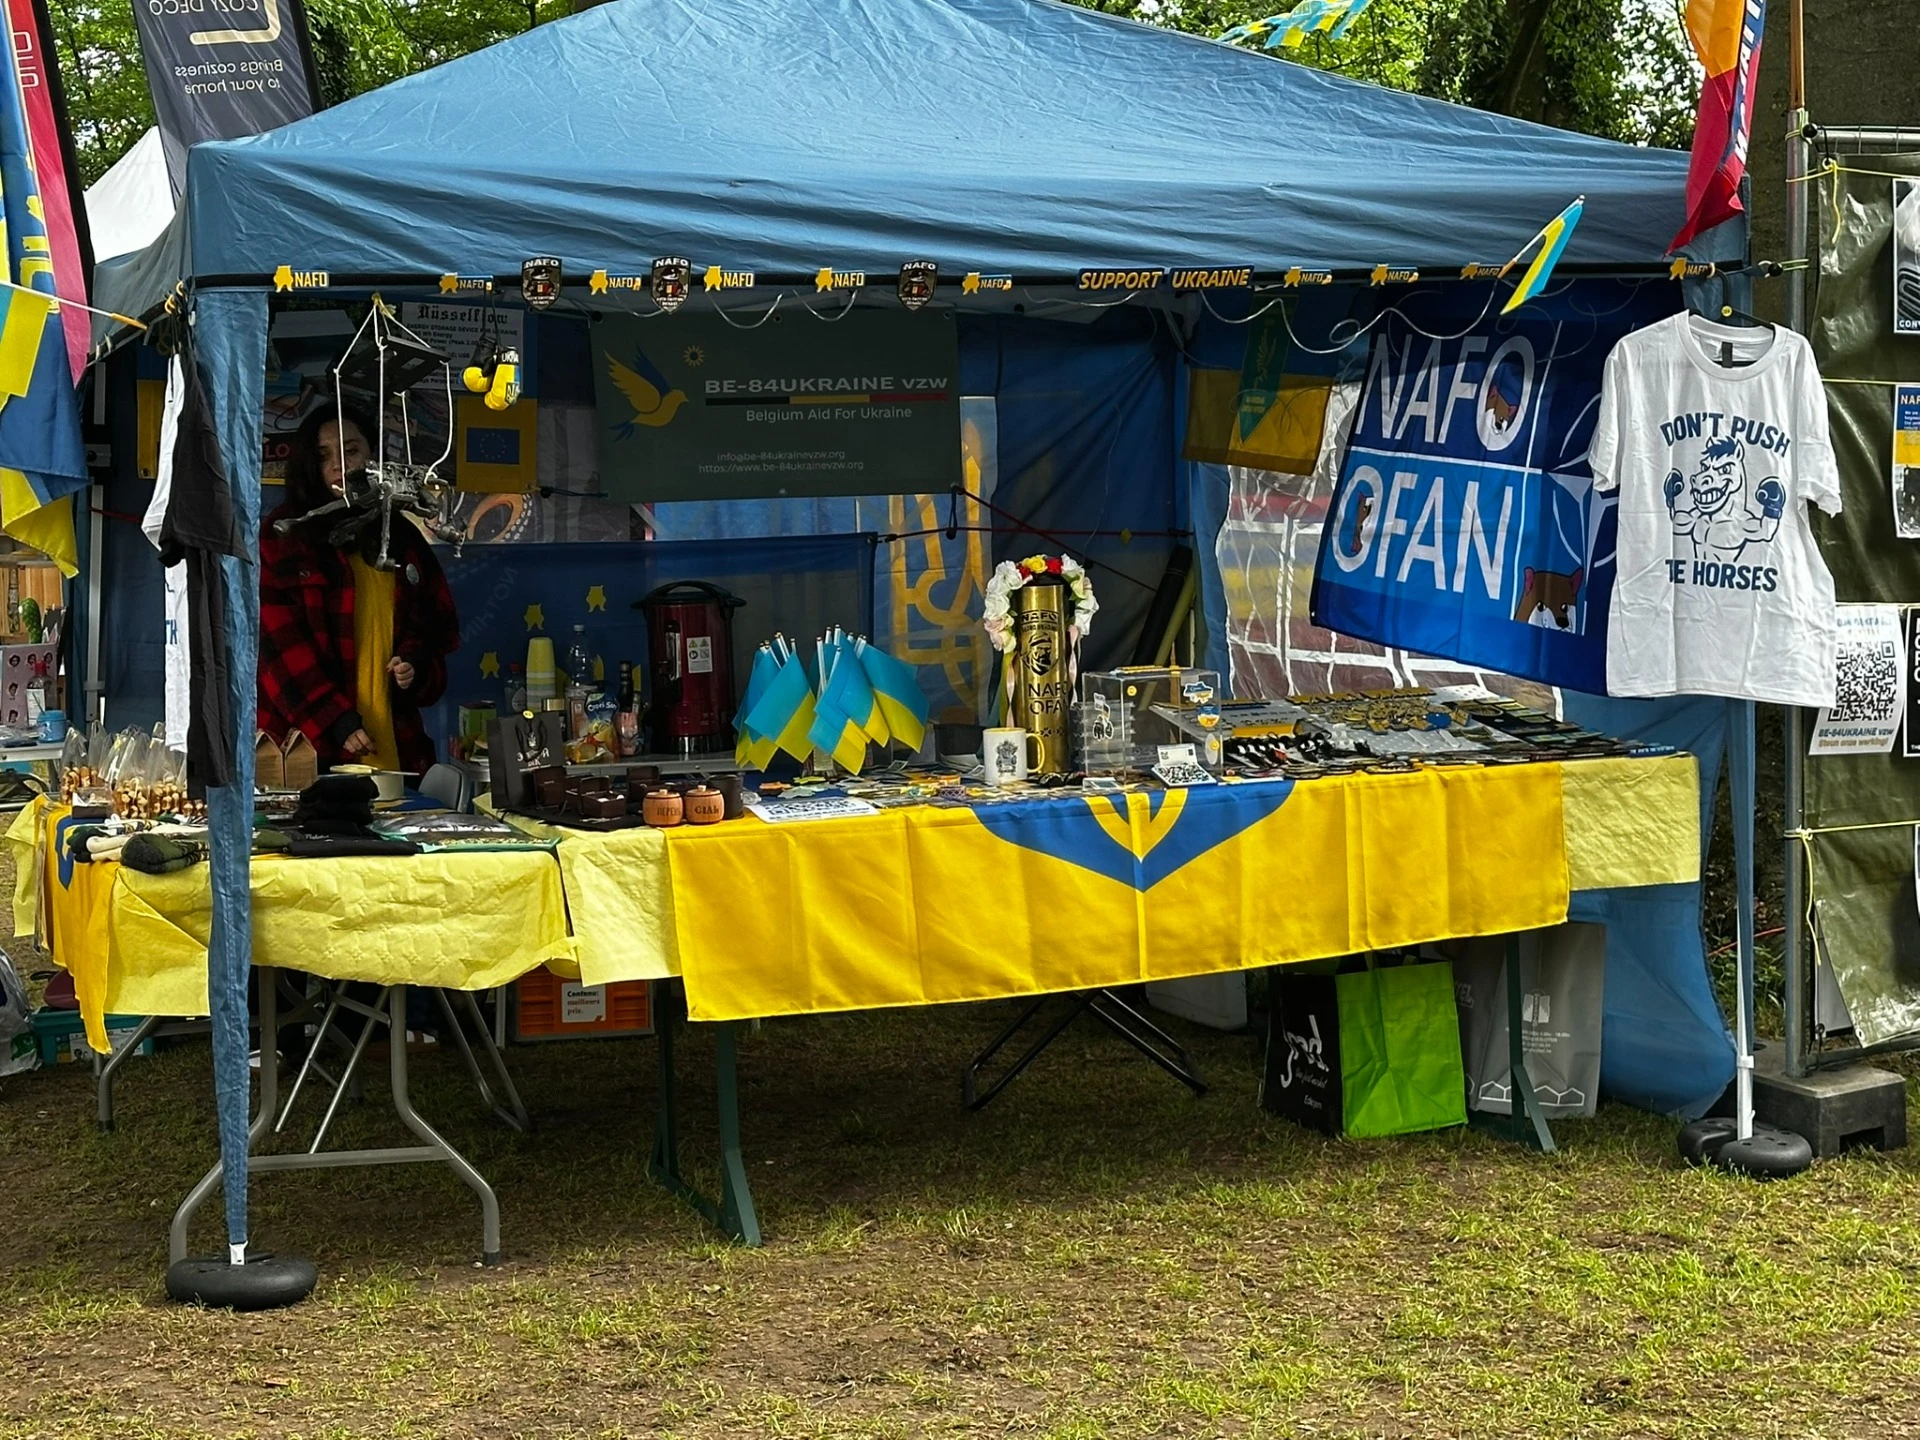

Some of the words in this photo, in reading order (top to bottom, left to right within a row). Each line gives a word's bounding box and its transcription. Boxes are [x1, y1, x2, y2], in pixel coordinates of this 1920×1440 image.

[525, 258, 559, 268] NAFO
[656, 257, 689, 267] NAFO
[903, 260, 937, 271] NAFO
[295, 271, 328, 287] NAFO
[723, 272, 754, 287] NAFO
[834, 273, 864, 287] NAFO
[1079, 271, 1163, 290] SUPPORT
[1171, 269, 1250, 288] UKRAINE
[1301, 273, 1323, 283] NAFO
[1388, 271, 1410, 281] NAFO
[459, 279, 484, 289] NAFO
[609, 277, 633, 289] NAFO
[981, 278, 1003, 289] NAFO
[705, 376, 895, 393] BE-84UKRAINE
[1355, 333, 1535, 451] NAFO
[746, 407, 803, 423] Belgium
[807, 408, 831, 420] Aid
[834, 407, 857, 420] For
[861, 406, 912, 419] Ukraine
[1730, 415, 1790, 457] PUSH
[717, 450, 846, 463] info@be-84ukrainevzw.org
[1332, 465, 1513, 600] OFAN
[1693, 560, 1778, 592] HORSES
[1819, 728, 1877, 737] BE-84UKRAINE
